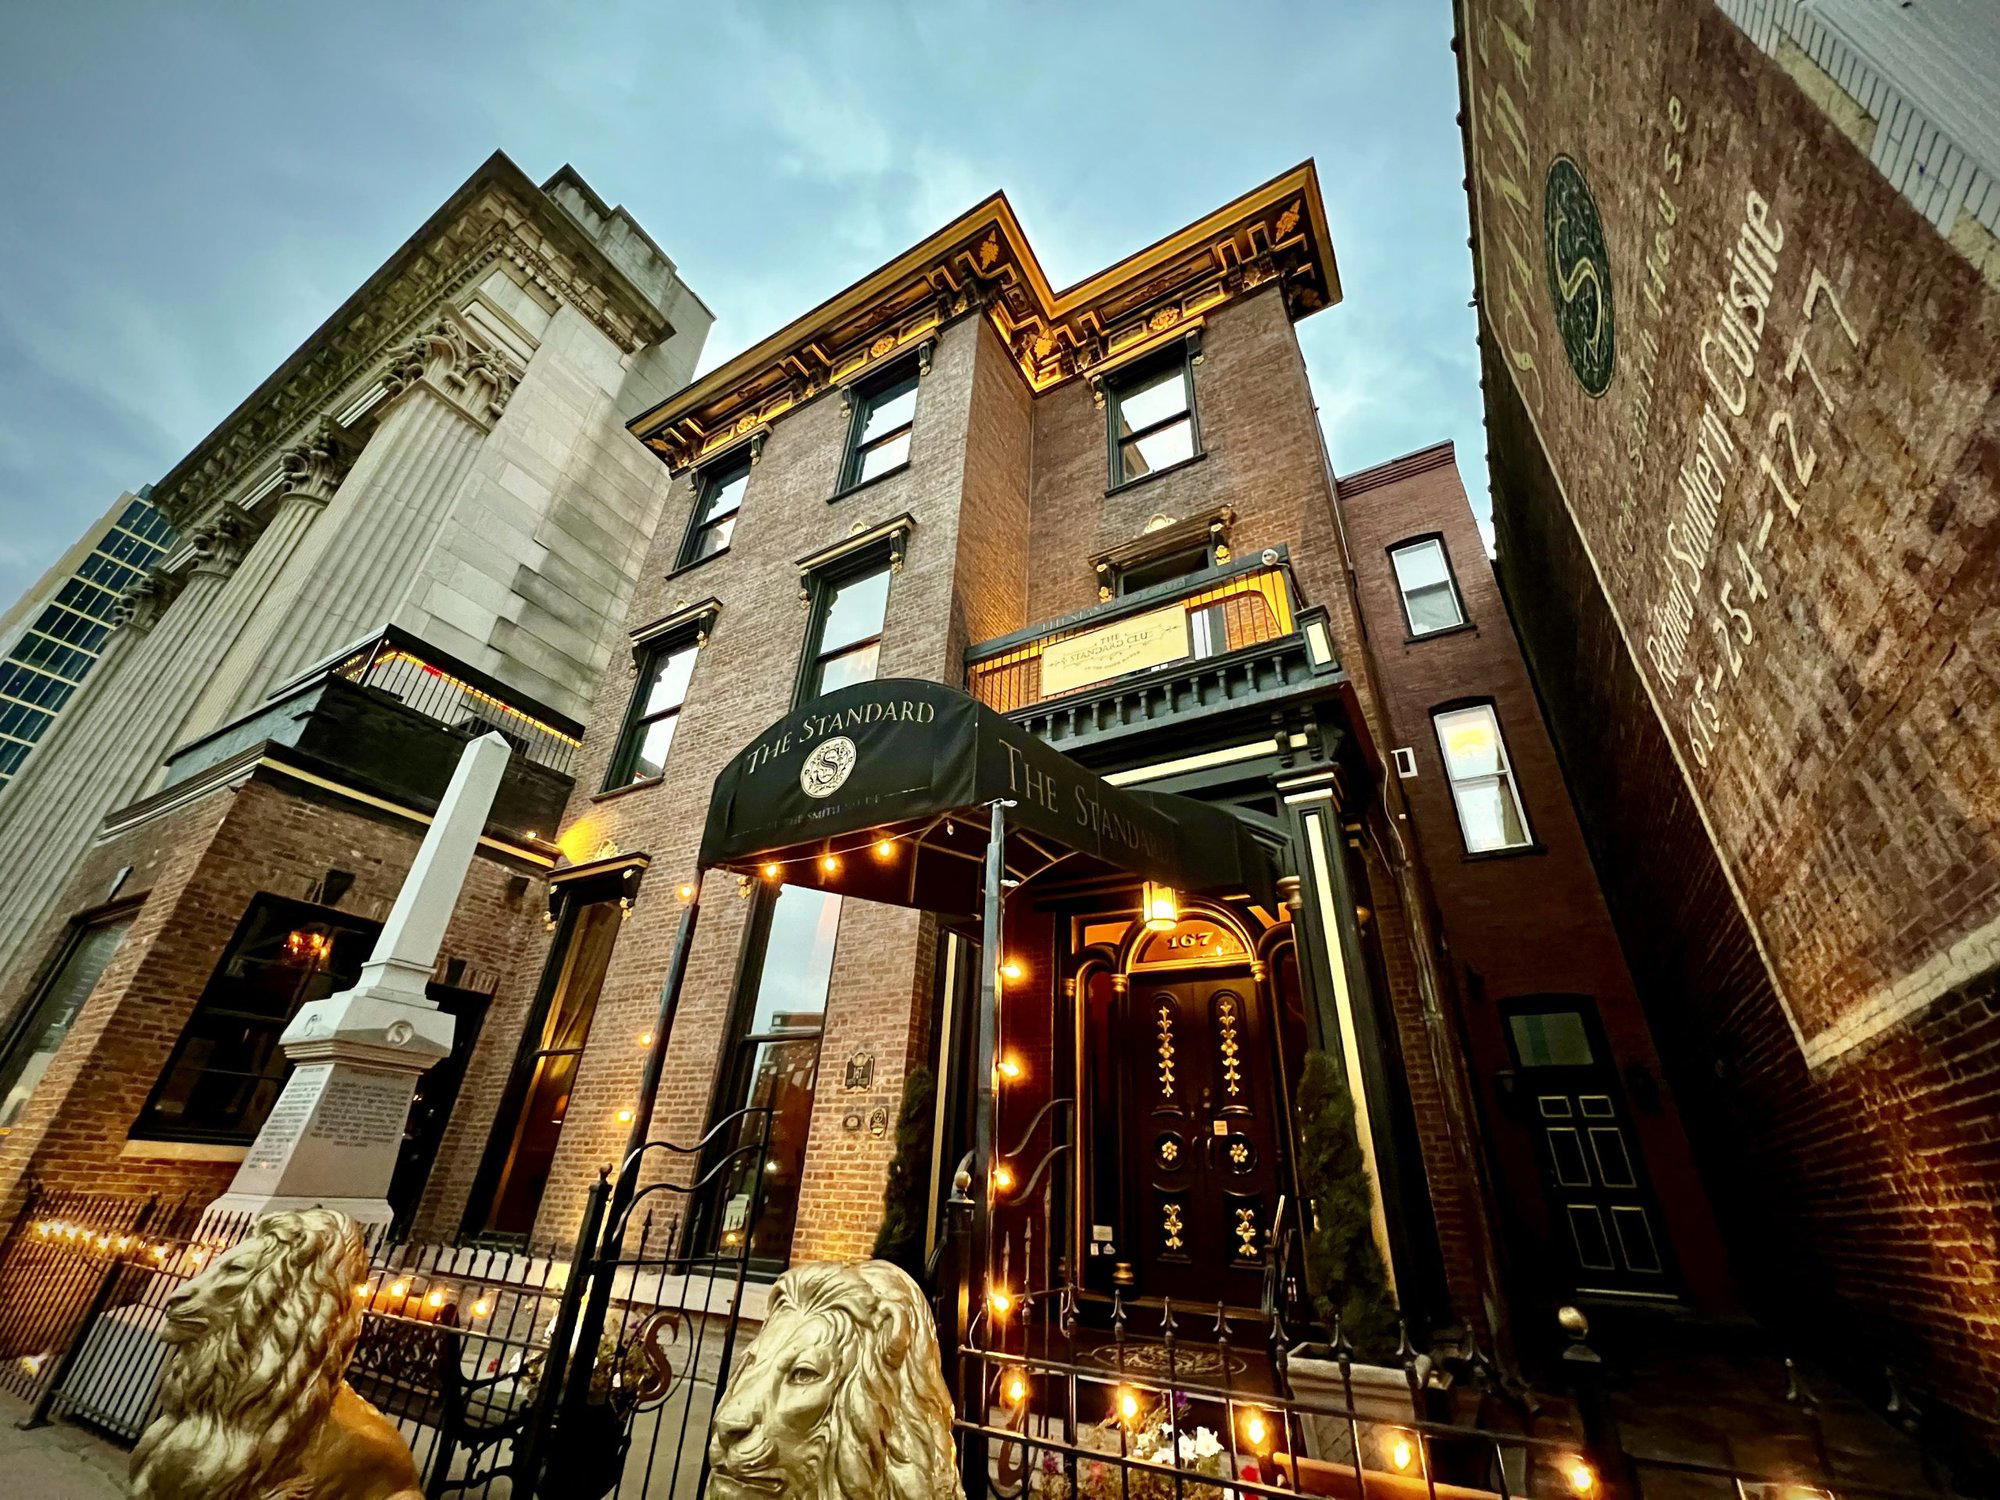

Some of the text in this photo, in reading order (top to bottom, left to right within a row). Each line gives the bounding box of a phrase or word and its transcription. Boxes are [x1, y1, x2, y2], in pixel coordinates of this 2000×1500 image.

[1643, 96, 1688, 318] House
[1699, 190, 1784, 417] Cuisine
[1666, 402, 1734, 597] Southern
[1126, 631, 1152, 646] CLU
[745, 701, 936, 776] THE STANDARD
[998, 737, 1060, 813] THE
[1167, 931, 1215, 950] 167
